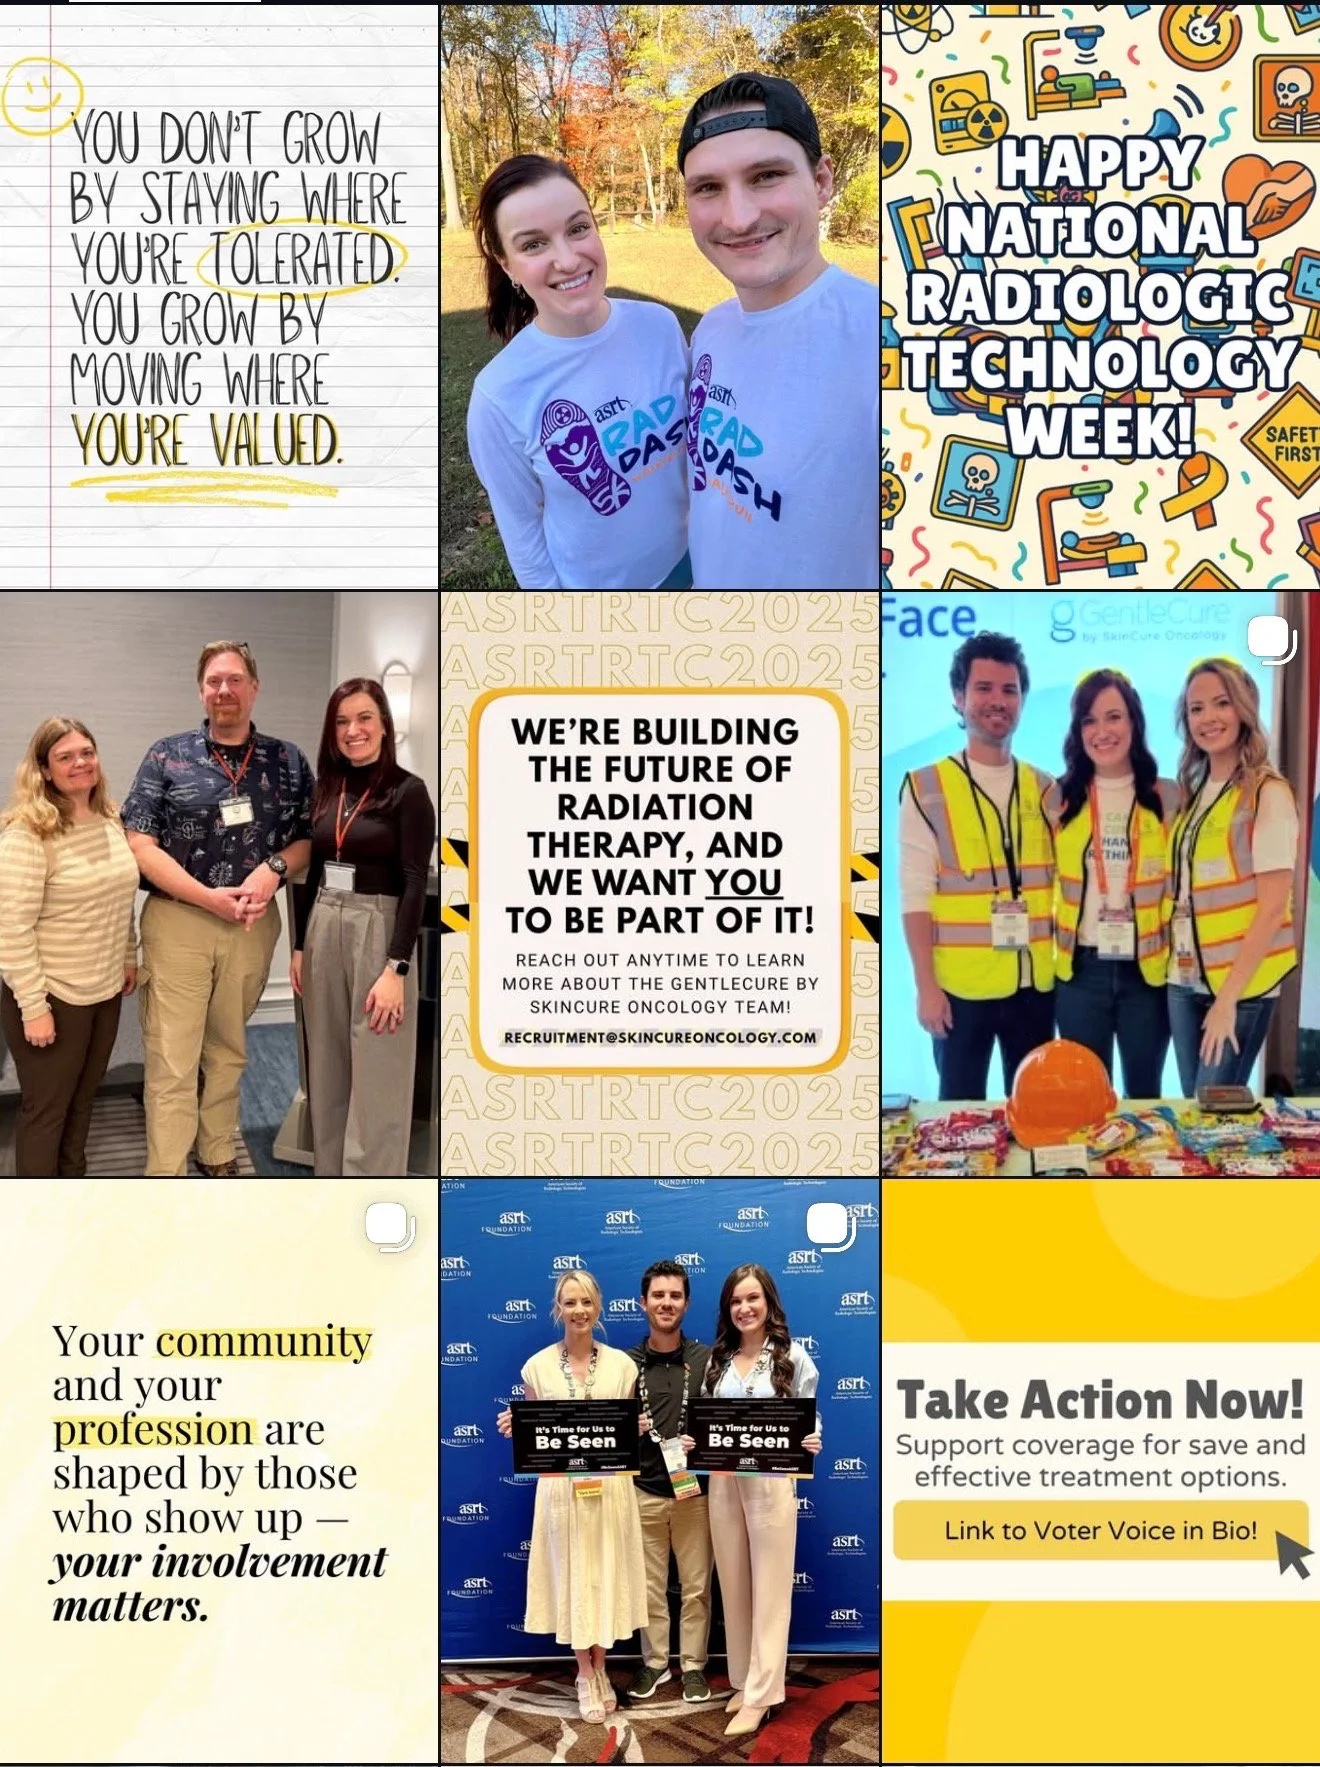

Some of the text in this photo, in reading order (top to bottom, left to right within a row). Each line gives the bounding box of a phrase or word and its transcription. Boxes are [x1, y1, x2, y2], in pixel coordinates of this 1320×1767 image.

[71, 108, 381, 165] YOU DON'T GROW
[1001, 138, 1200, 188] HAPPY
[70, 170, 407, 226] BY STAYING WHERE
[947, 205, 1256, 255] NATIONAL
[71, 231, 399, 286] YOU'RE TOLERATED.
[910, 272, 1290, 323] RADIOLOGIC
[71, 289, 328, 347] YOU GROW BY
[903, 339, 1300, 389] TECHNOLOGY
[70, 351, 329, 407] MOVING WHERE
[594, 395, 627, 423] asrt
[708, 384, 733, 406] asrt
[71, 412, 342, 467] YOU'RE VALUED.
[601, 395, 676, 457] RAD
[700, 406, 764, 458] RAD
[1006, 406, 1195, 457] WEEK!
[1266, 425, 1320, 443] SAFET
[1275, 445, 1320, 462] FIRST
[702, 437, 782, 522] DASH
[441, 592, 879, 633] ASRTRTC2025
[1080, 598, 1231, 626] GentleCure
[1082, 630, 1227, 643] by SkinCure Oncology
[441, 644, 879, 690] ASRTRTC2025
[511, 717, 799, 746] WE’RE BUILDING
[528, 755, 792, 783] THE FUTURE OF
[558, 793, 752, 821] RADIATION
[527, 831, 783, 864] THERAPY, AND
[1102, 837, 1128, 847] HAN
[527, 868, 781, 896] WE WANT YOU
[505, 905, 814, 934] TO BE PART OF IT!
[516, 953, 805, 967] REACH OUT ANYTIME TO LEARN
[502, 977, 819, 991] MORE ABOUT THE GENTLECURE BY
[530, 1000, 790, 1014] SKINCURE ONCOLOGY TEAM!
[504, 1032, 816, 1044] RECRUITMENT@SKINCUREONCOLOGY.COM
[441, 1075, 879, 1120] ASRTRTC2025
[441, 1132, 879, 1176] ASRTRTC2025
[499, 1210, 527, 1224] asrt
[606, 1209, 635, 1225] asrt
[719, 1221, 769, 1229] FOUNDATION
[737, 1205, 765, 1220] asrt
[441, 1255, 466, 1269] asrt
[553, 1254, 582, 1269] asrt
[674, 1252, 700, 1266] asrt
[788, 1248, 818, 1264] asrt
[505, 1298, 531, 1312] asrt
[609, 1297, 638, 1313] asrt
[840, 1290, 870, 1306] asrt
[52, 1323, 372, 1365] Your community
[446, 1341, 473, 1355] asrt
[53, 1366, 222, 1409] and your
[511, 1384, 525, 1396] as
[837, 1375, 866, 1390] asrt
[897, 1378, 1303, 1420] Take Action Now!
[54, 1411, 325, 1453] profession are
[453, 1424, 479, 1436] asrt
[535, 1434, 617, 1450] Be Seen
[536, 1426, 550, 1434] It's
[552, 1425, 575, 1433] Time
[576, 1425, 590, 1433] for
[592, 1425, 604, 1433] Us
[708, 1433, 790, 1449] Be Seen
[709, 1424, 723, 1432] It's
[725, 1424, 748, 1432] Time
[749, 1424, 763, 1432] for
[896, 1433, 1305, 1462] Support coverage for save and
[54, 1454, 357, 1497] shaped by those
[834, 1456, 862, 1471] asrt
[915, 1464, 1287, 1493] effective treatment options.
[52, 1499, 132, 1534] who
[145, 1499, 244, 1534] show
[255, 1509, 303, 1541] up
[459, 1502, 485, 1514] asrt
[832, 1534, 860, 1547] asrt
[946, 1520, 1257, 1540] Link to Voter Voice in Bio!
[47, 1542, 387, 1585] your involvement
[464, 1577, 488, 1588] asrt
[53, 1591, 208, 1622] matters.
[831, 1608, 858, 1620] asrt
